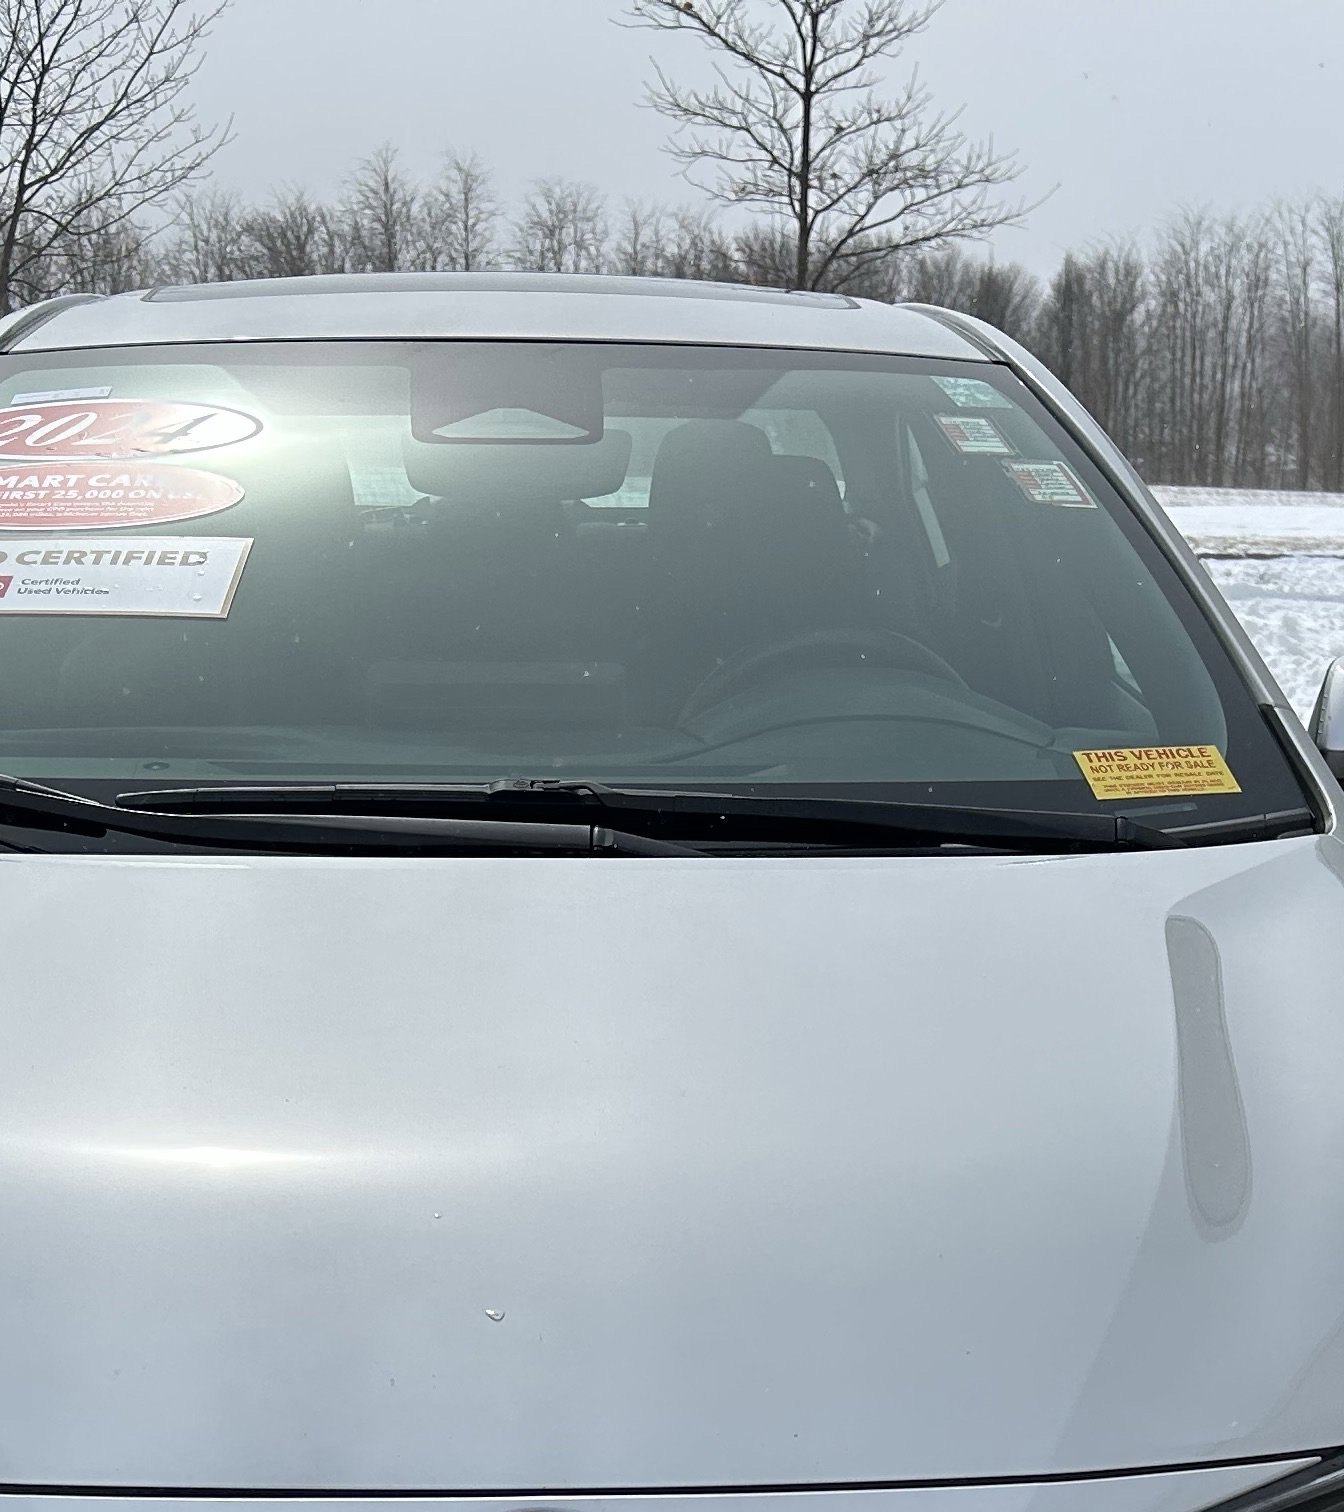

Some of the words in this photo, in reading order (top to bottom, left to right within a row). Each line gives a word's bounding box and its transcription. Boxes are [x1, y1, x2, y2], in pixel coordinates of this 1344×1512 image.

[52, 489, 125, 501] 25,000
[129, 489, 161, 500] ON
[15, 550, 208, 567] CERTIFIED
[21, 577, 81, 586] Certified
[17, 587, 52, 596] Used
[55, 587, 110, 596] Vehicles
[1081, 751, 1128, 764] THIS
[1130, 747, 1212, 761] VEHICLE
[1089, 764, 1115, 774] NOT
[1116, 762, 1157, 773] READY
[1159, 761, 1183, 771] FOR
[1185, 759, 1217, 770] SALE
